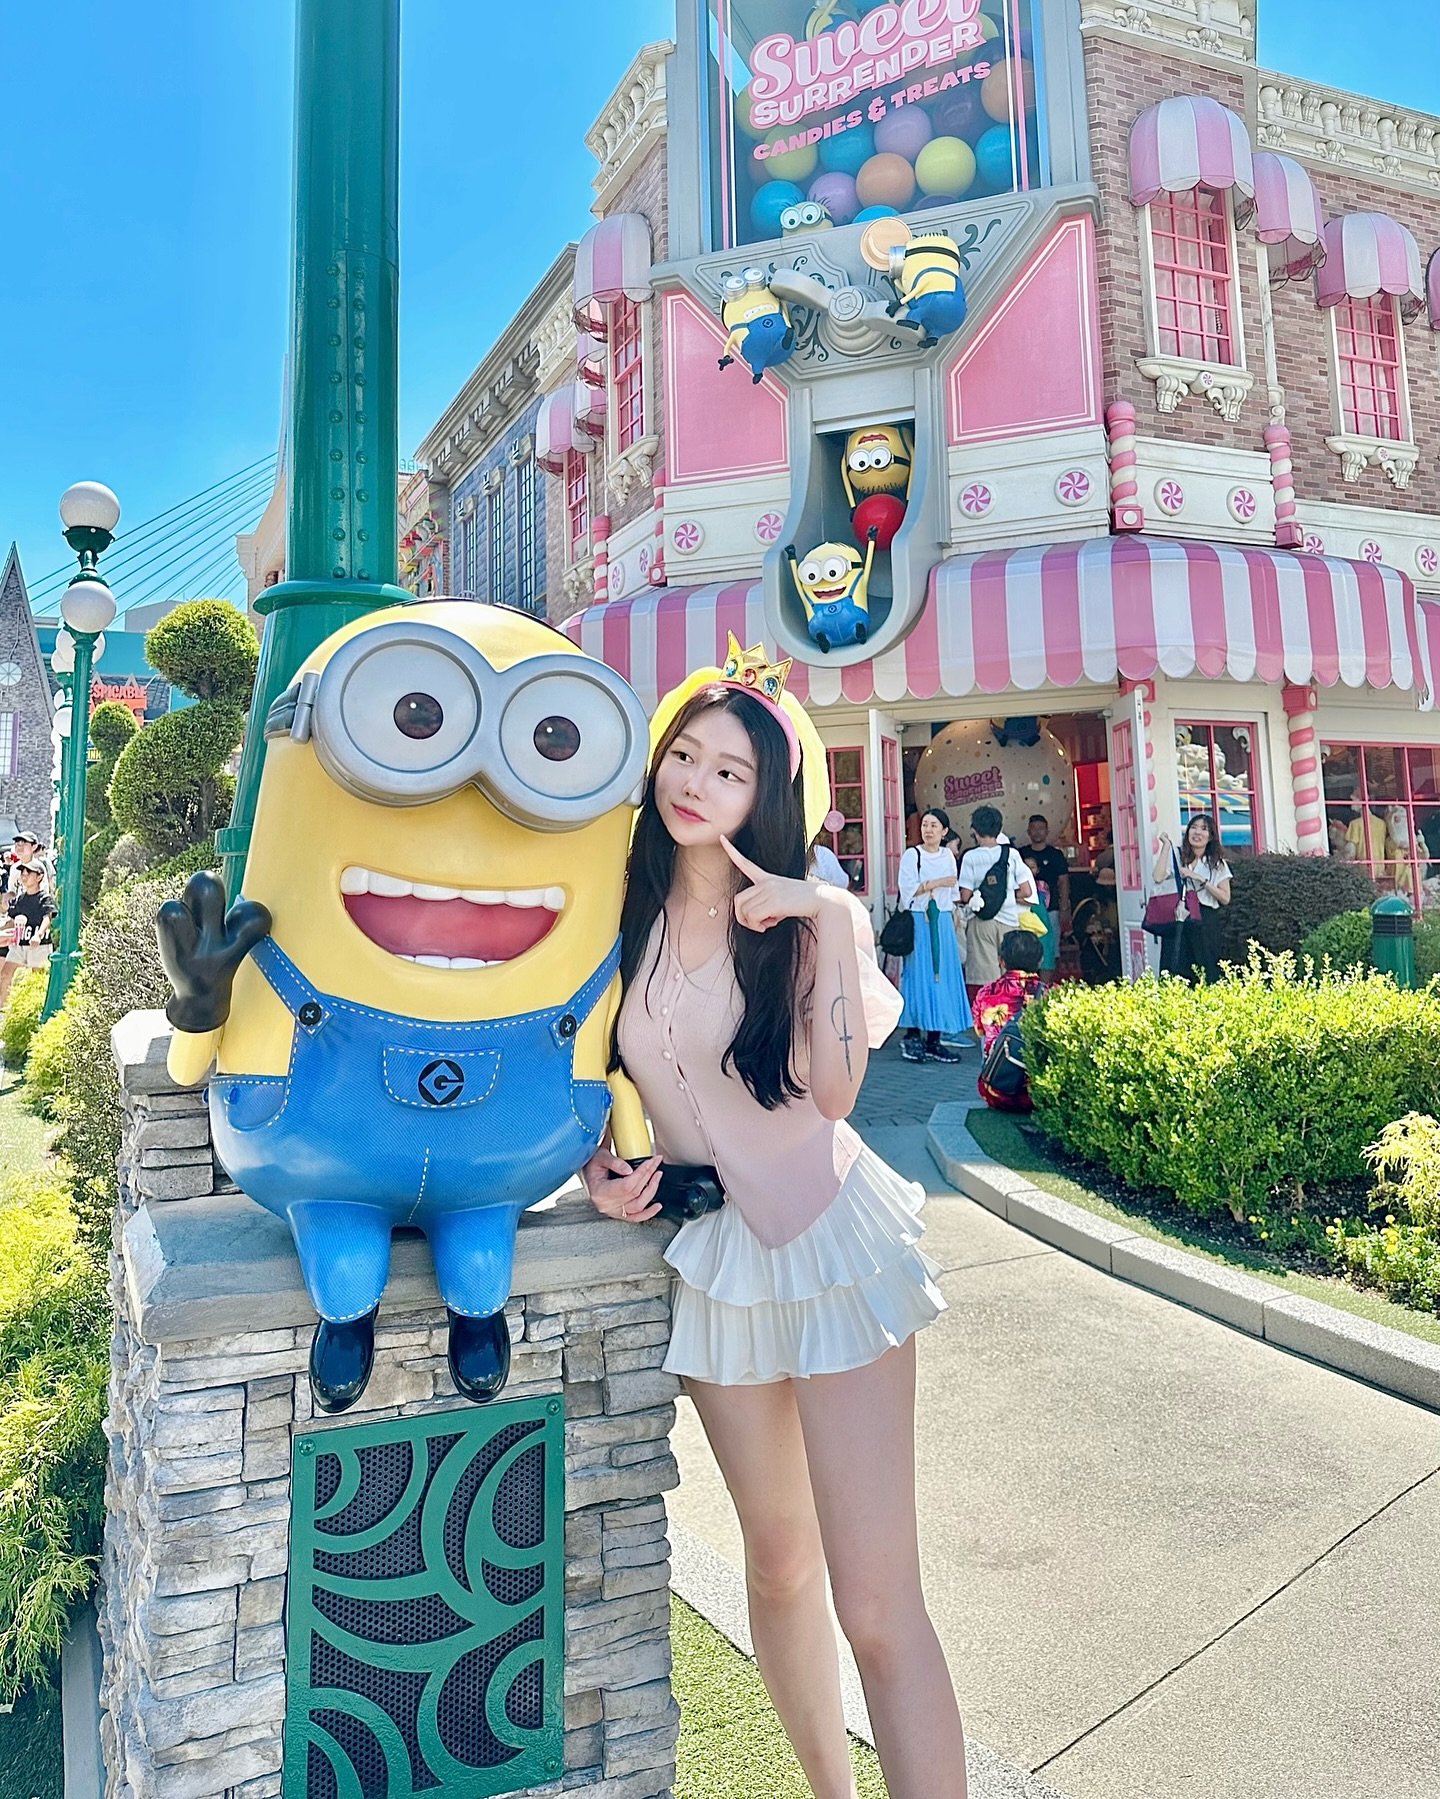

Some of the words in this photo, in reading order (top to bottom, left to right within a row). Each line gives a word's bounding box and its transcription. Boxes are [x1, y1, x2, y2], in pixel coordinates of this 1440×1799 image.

[753, 21, 981, 125] SURRENDER
[753, 109, 863, 160] CANDIES
[867, 97, 887, 122] &
[891, 61, 991, 109] TREATS
[91, 684, 147, 699] SPICABLE
[944, 766, 1001, 793] Sweet
